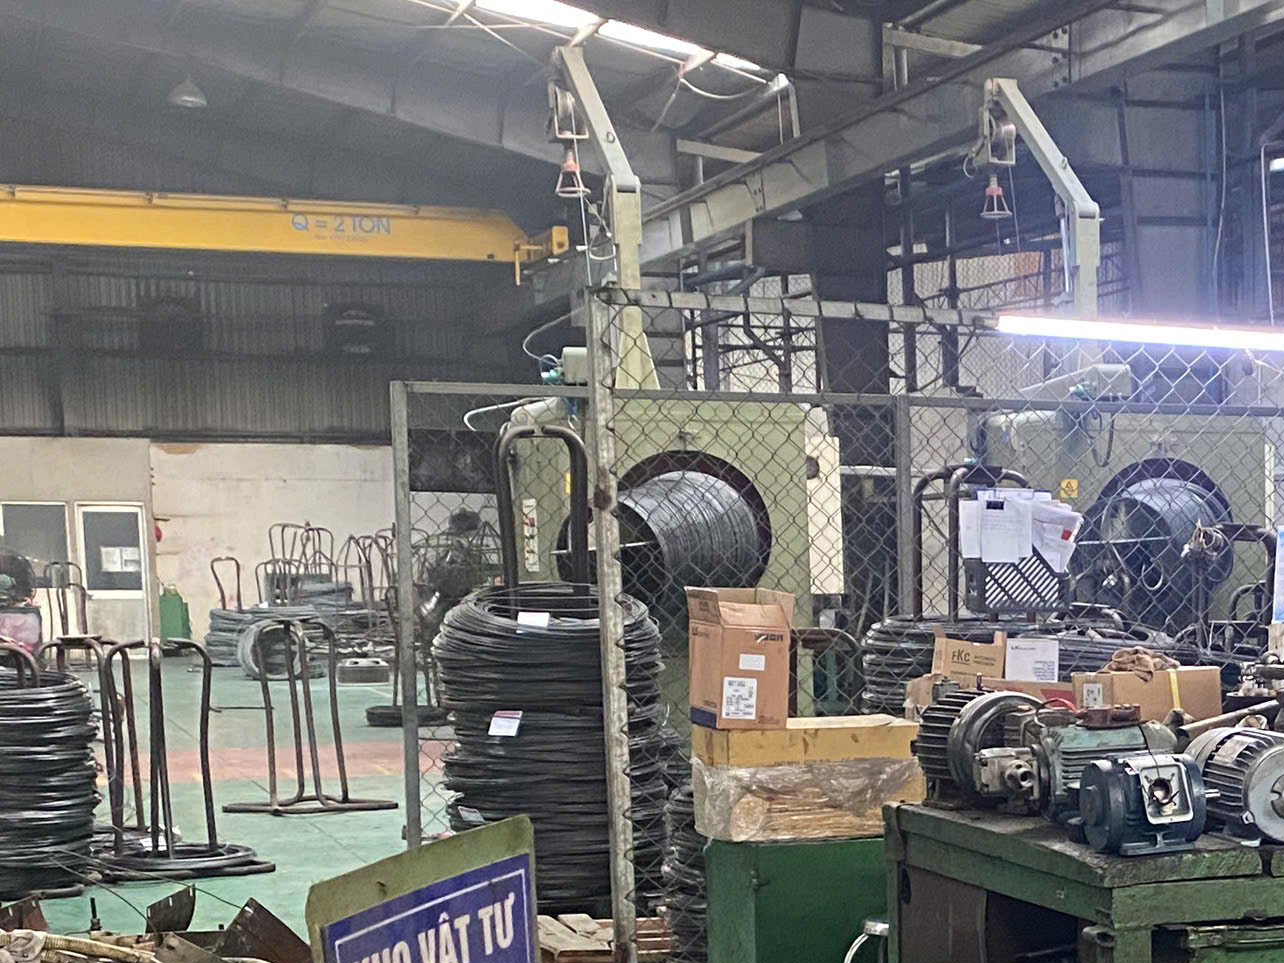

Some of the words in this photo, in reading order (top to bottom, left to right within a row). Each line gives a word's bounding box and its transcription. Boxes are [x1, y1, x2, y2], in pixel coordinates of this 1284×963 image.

[334, 215, 345, 233] 2
[351, 215, 391, 234] TON
[952, 649, 970, 662] FKC
[478, 891, 515, 956] TƯ
